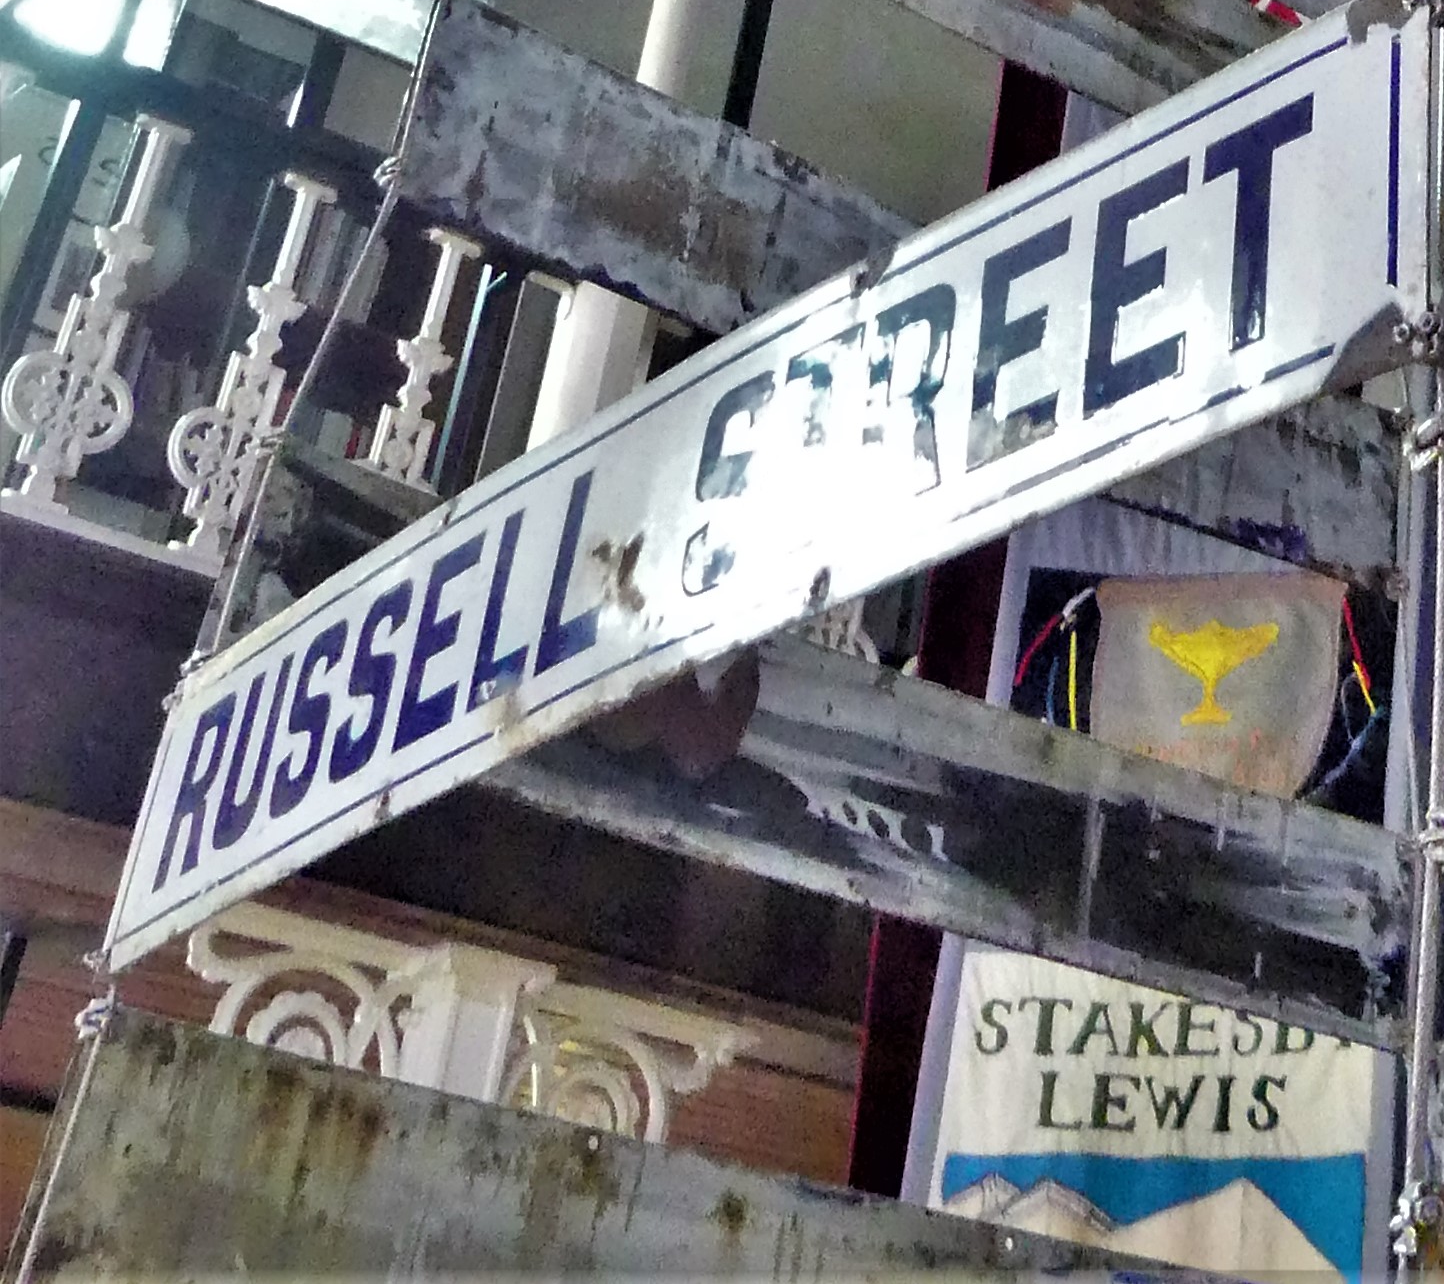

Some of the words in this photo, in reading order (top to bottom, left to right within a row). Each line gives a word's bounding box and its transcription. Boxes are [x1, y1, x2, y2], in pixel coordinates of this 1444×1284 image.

[152, 467, 599, 893] RUSSELL
[974, 996, 1353, 1059] STAKESB
[1035, 1070, 1288, 1133] LEWIS
